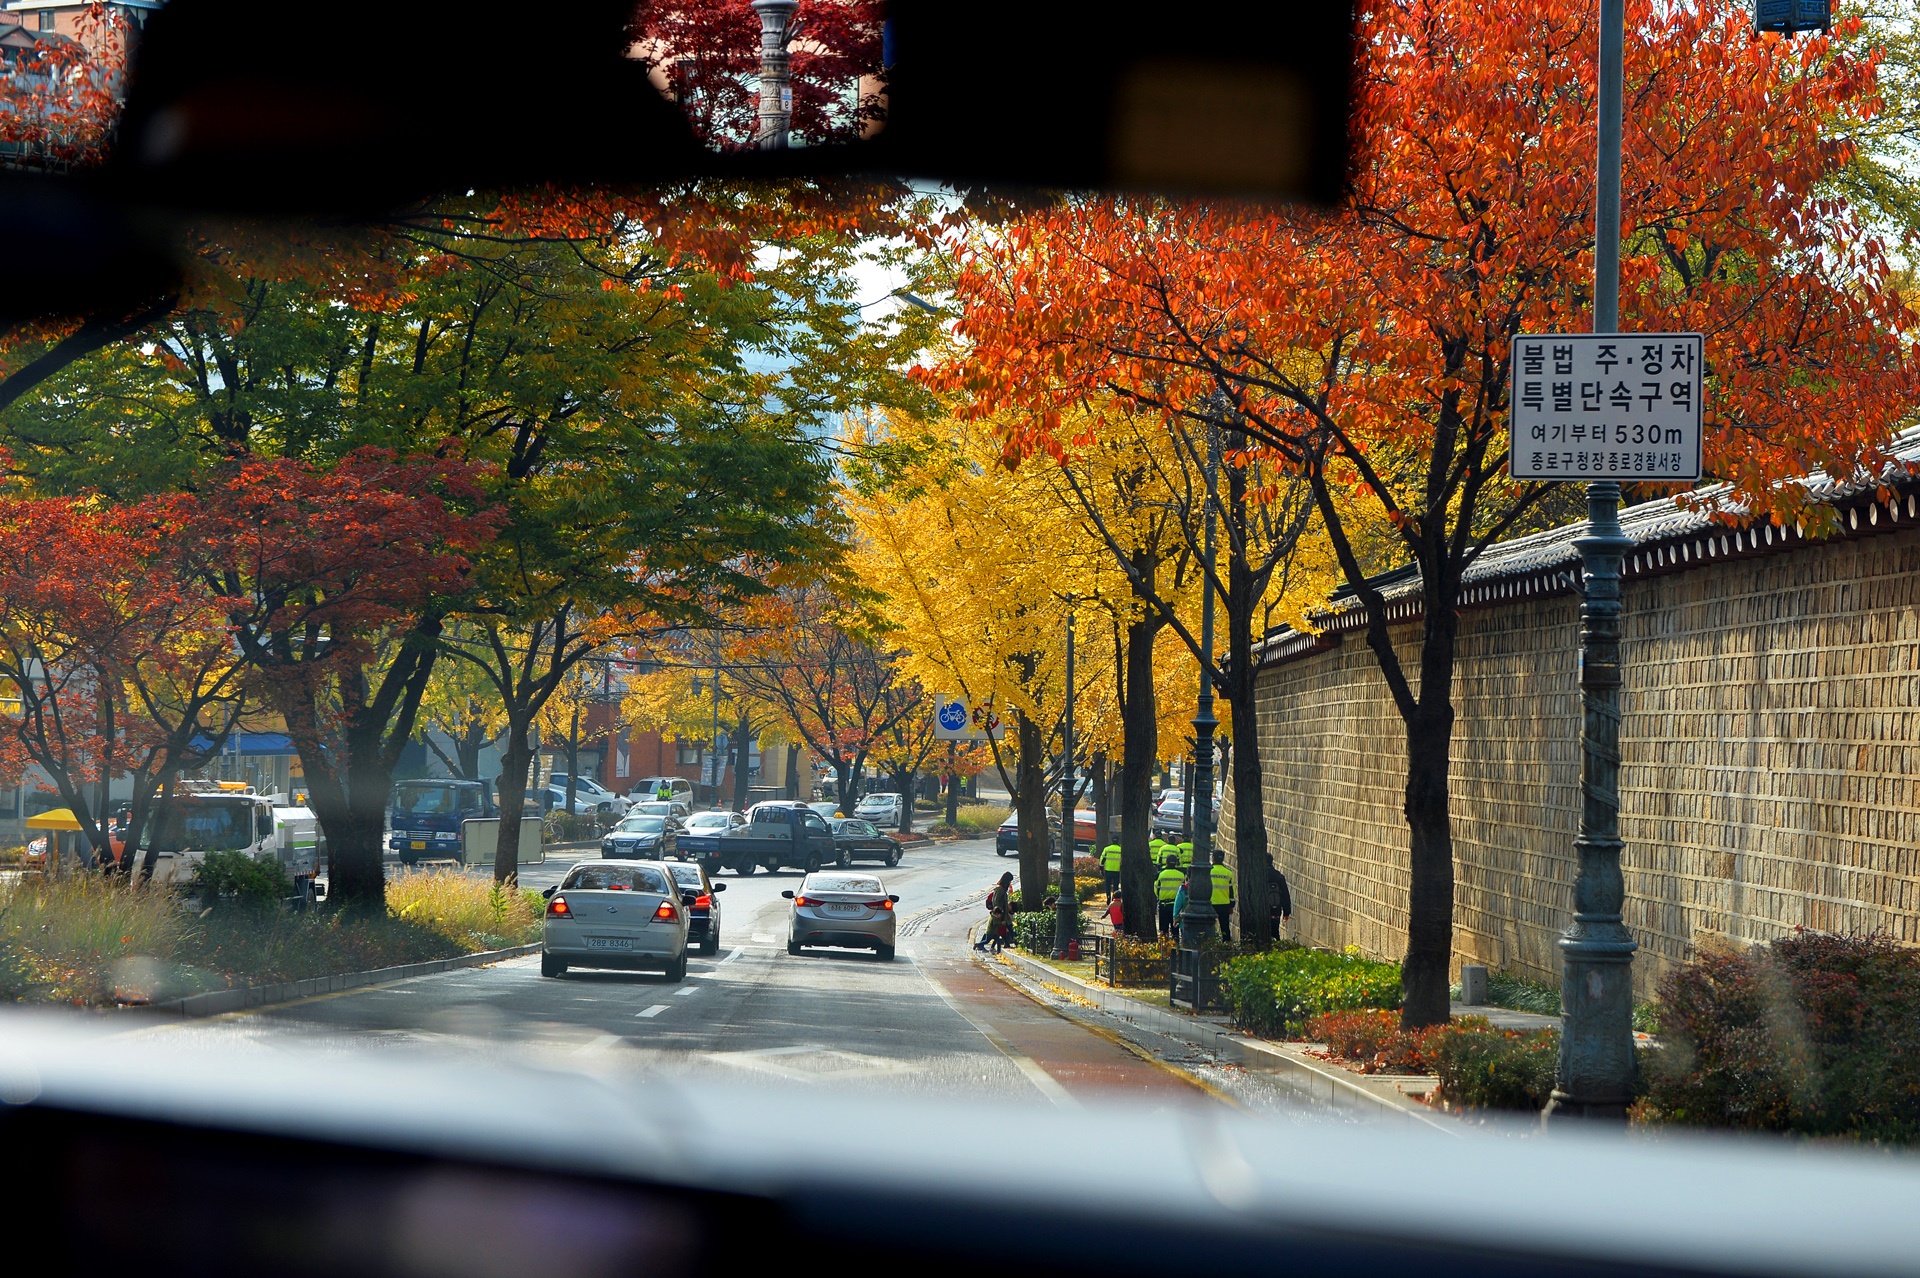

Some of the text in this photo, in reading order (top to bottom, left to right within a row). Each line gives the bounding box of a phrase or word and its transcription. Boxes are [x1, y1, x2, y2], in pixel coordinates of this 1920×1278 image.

[1522, 344, 1695, 375] 불법 주·정차
[1521, 380, 1691, 412] 특별단속구역
[1531, 424, 1682, 444] 여기부터 530m
[1531, 451, 1681, 472] 종로구청장 종로경찰서장
[609, 939, 629, 948] 8346
